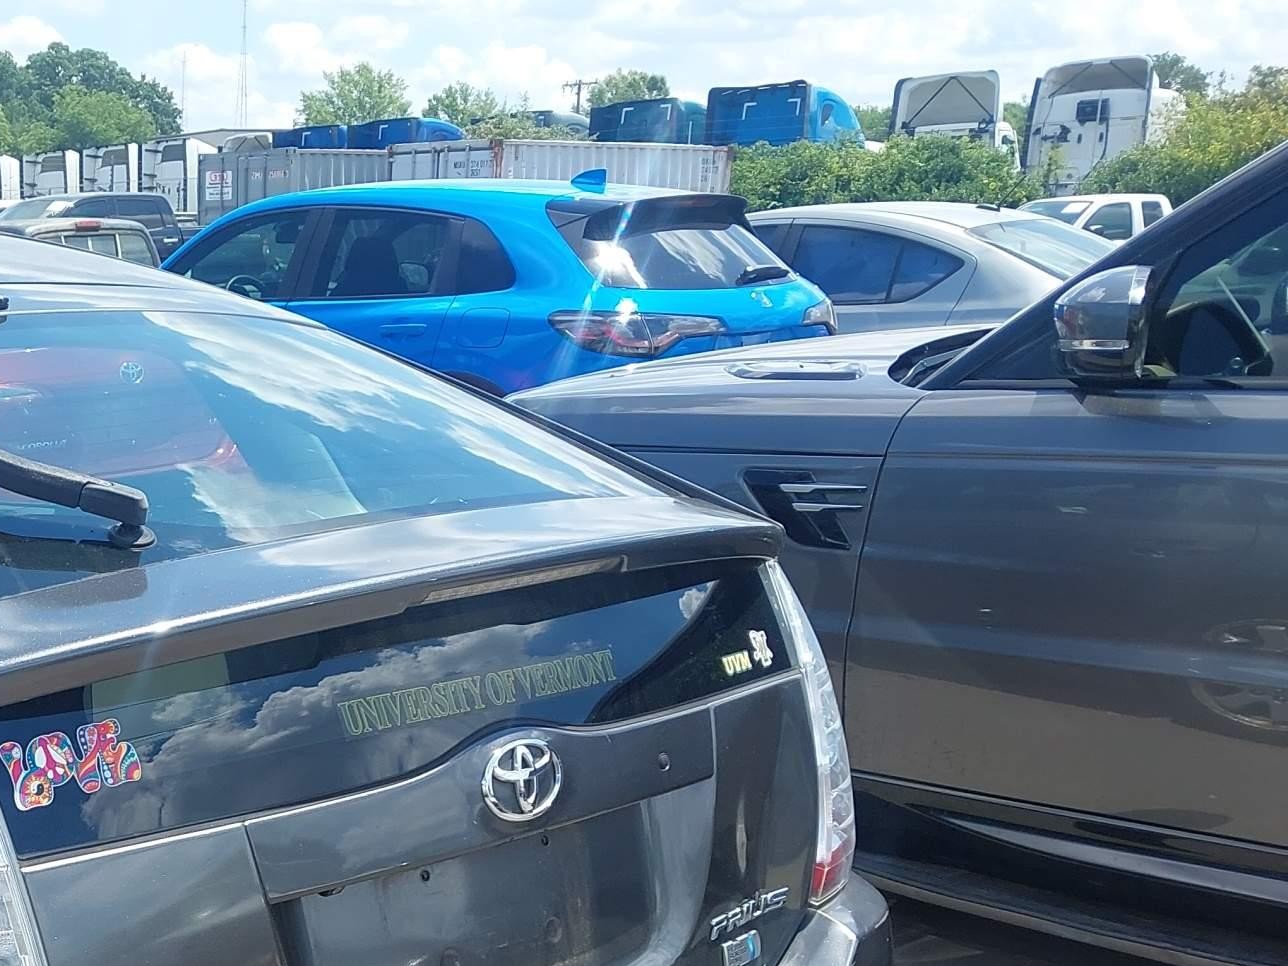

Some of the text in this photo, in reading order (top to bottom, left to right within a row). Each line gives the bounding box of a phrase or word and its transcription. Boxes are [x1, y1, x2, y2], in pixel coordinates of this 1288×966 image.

[337, 650, 617, 735] UNIVERSITY OF VERMONT
[722, 650, 752, 676] UVM
[0, 718, 142, 812] LOVE
[710, 887, 789, 940] PRIUS
